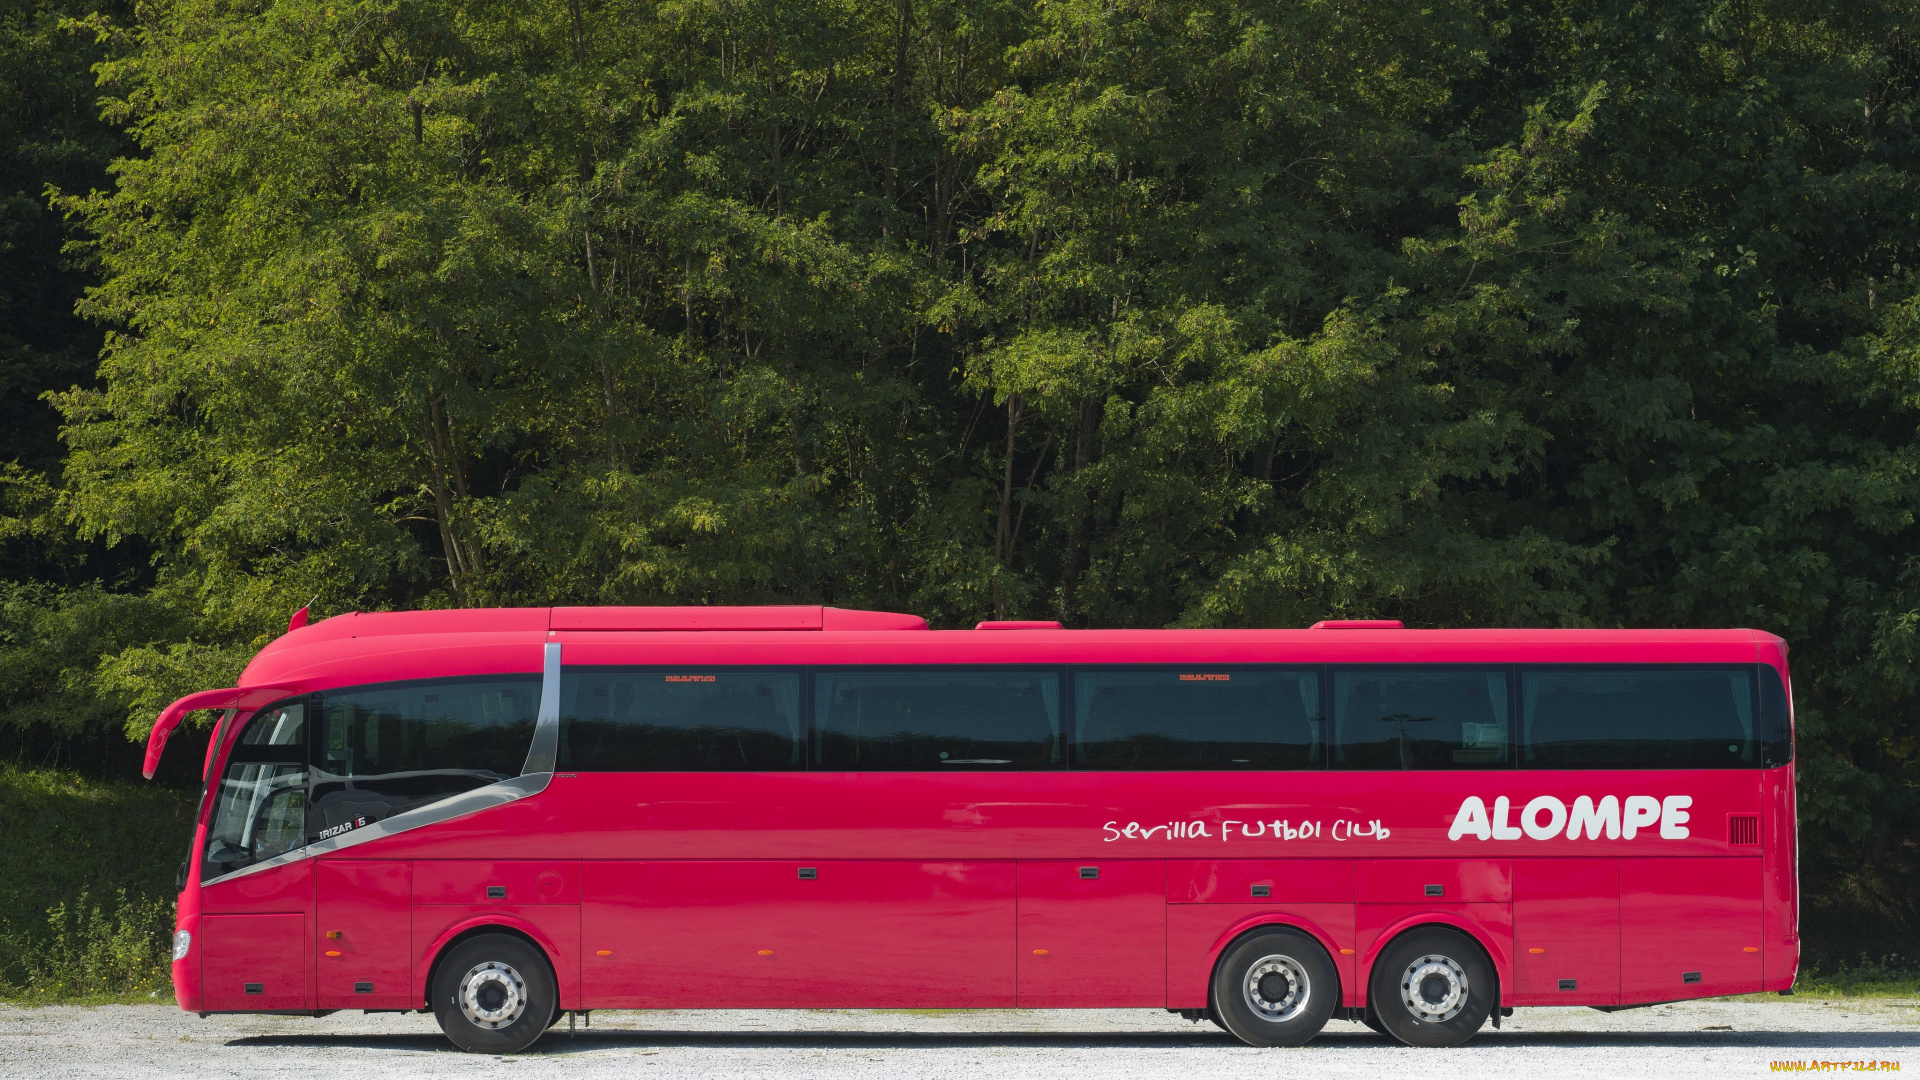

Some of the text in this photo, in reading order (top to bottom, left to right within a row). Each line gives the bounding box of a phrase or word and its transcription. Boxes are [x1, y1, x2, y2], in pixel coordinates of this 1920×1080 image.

[319, 817, 366, 840] IRIZAR i6
[1448, 795, 1693, 841] ALOMPE
